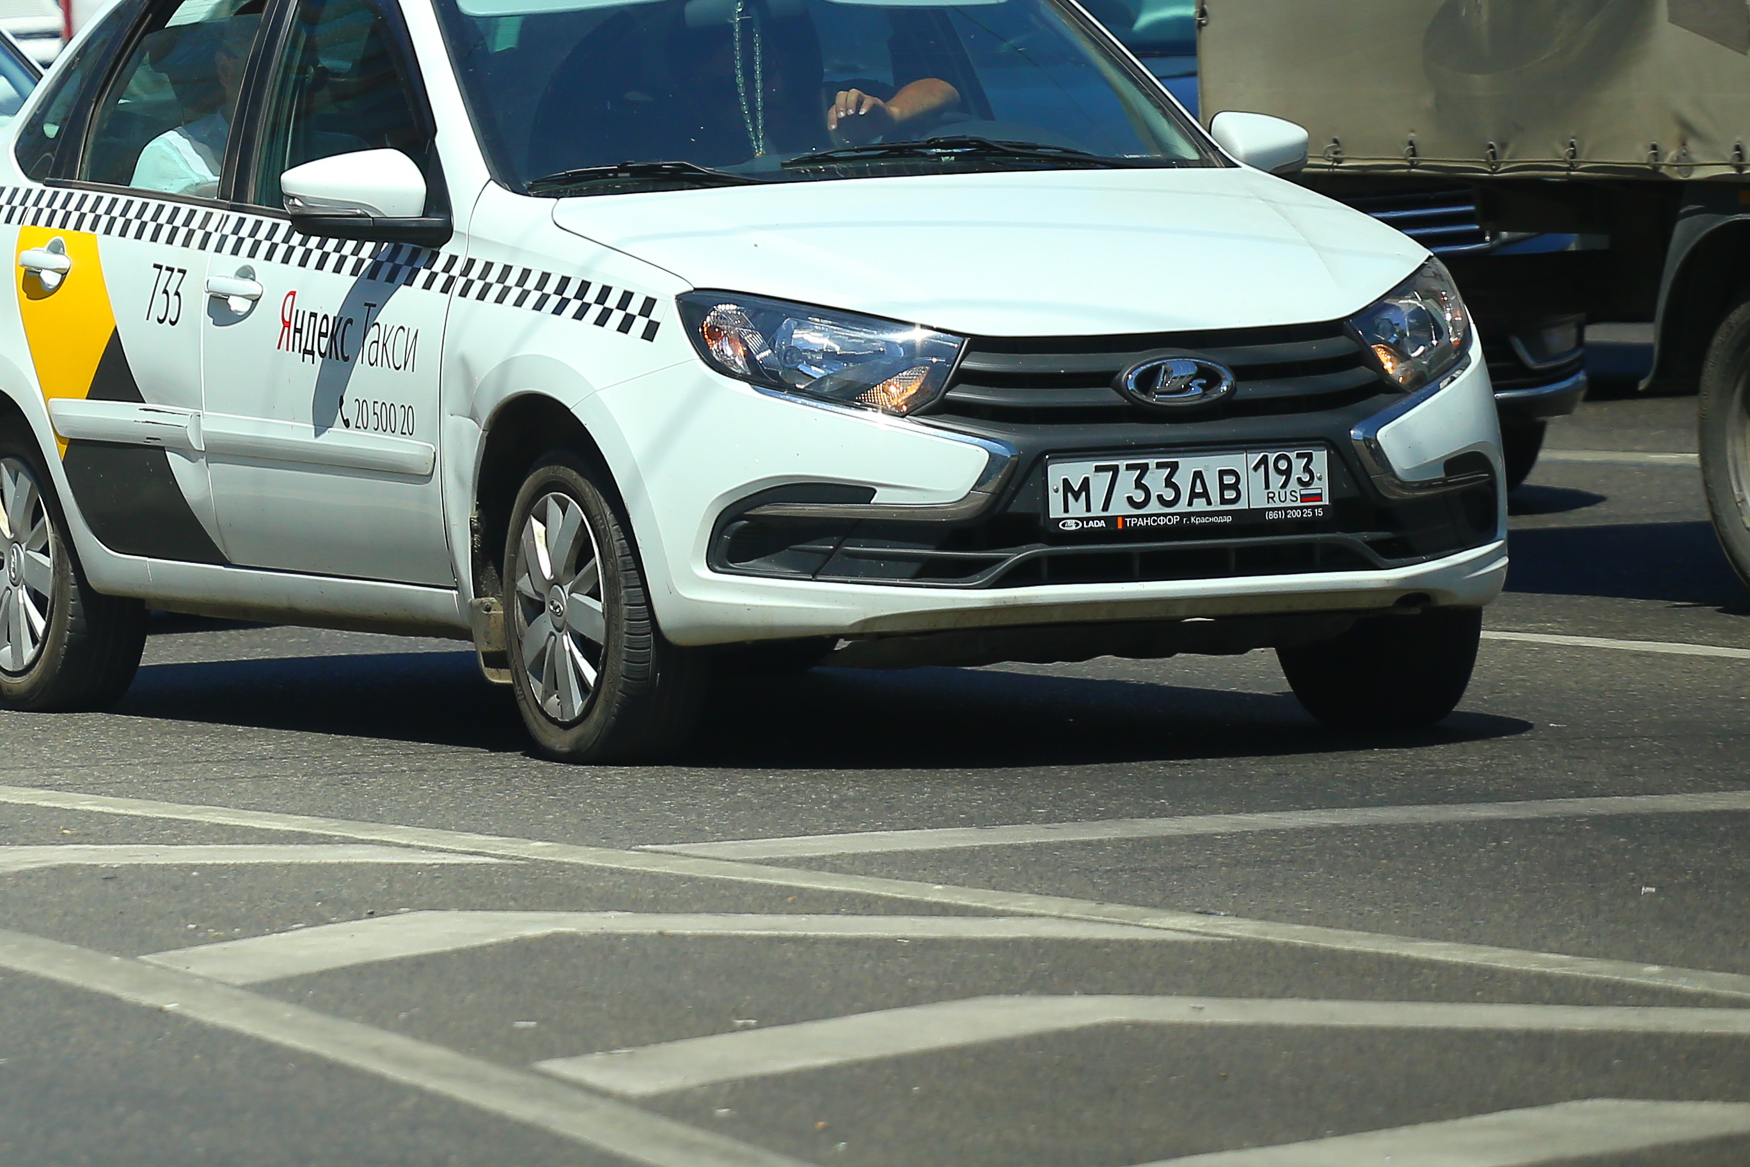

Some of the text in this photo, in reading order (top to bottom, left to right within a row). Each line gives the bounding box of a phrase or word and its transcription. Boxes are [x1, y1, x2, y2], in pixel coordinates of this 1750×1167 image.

[146, 263, 188, 326] 733
[277, 290, 420, 373] Яндекс Такси
[354, 398, 415, 436] 20 500 20
[1061, 451, 1316, 514] М733АВ 193
[1267, 489, 1299, 504] RUS
[1083, 519, 1106, 529] LADA
[1125, 515, 1180, 527] ТРАНСФОР
[1190, 514, 1232, 525] Краснодар
[1265, 510, 1286, 521] (861)
[1287, 509, 1301, 519] 200
